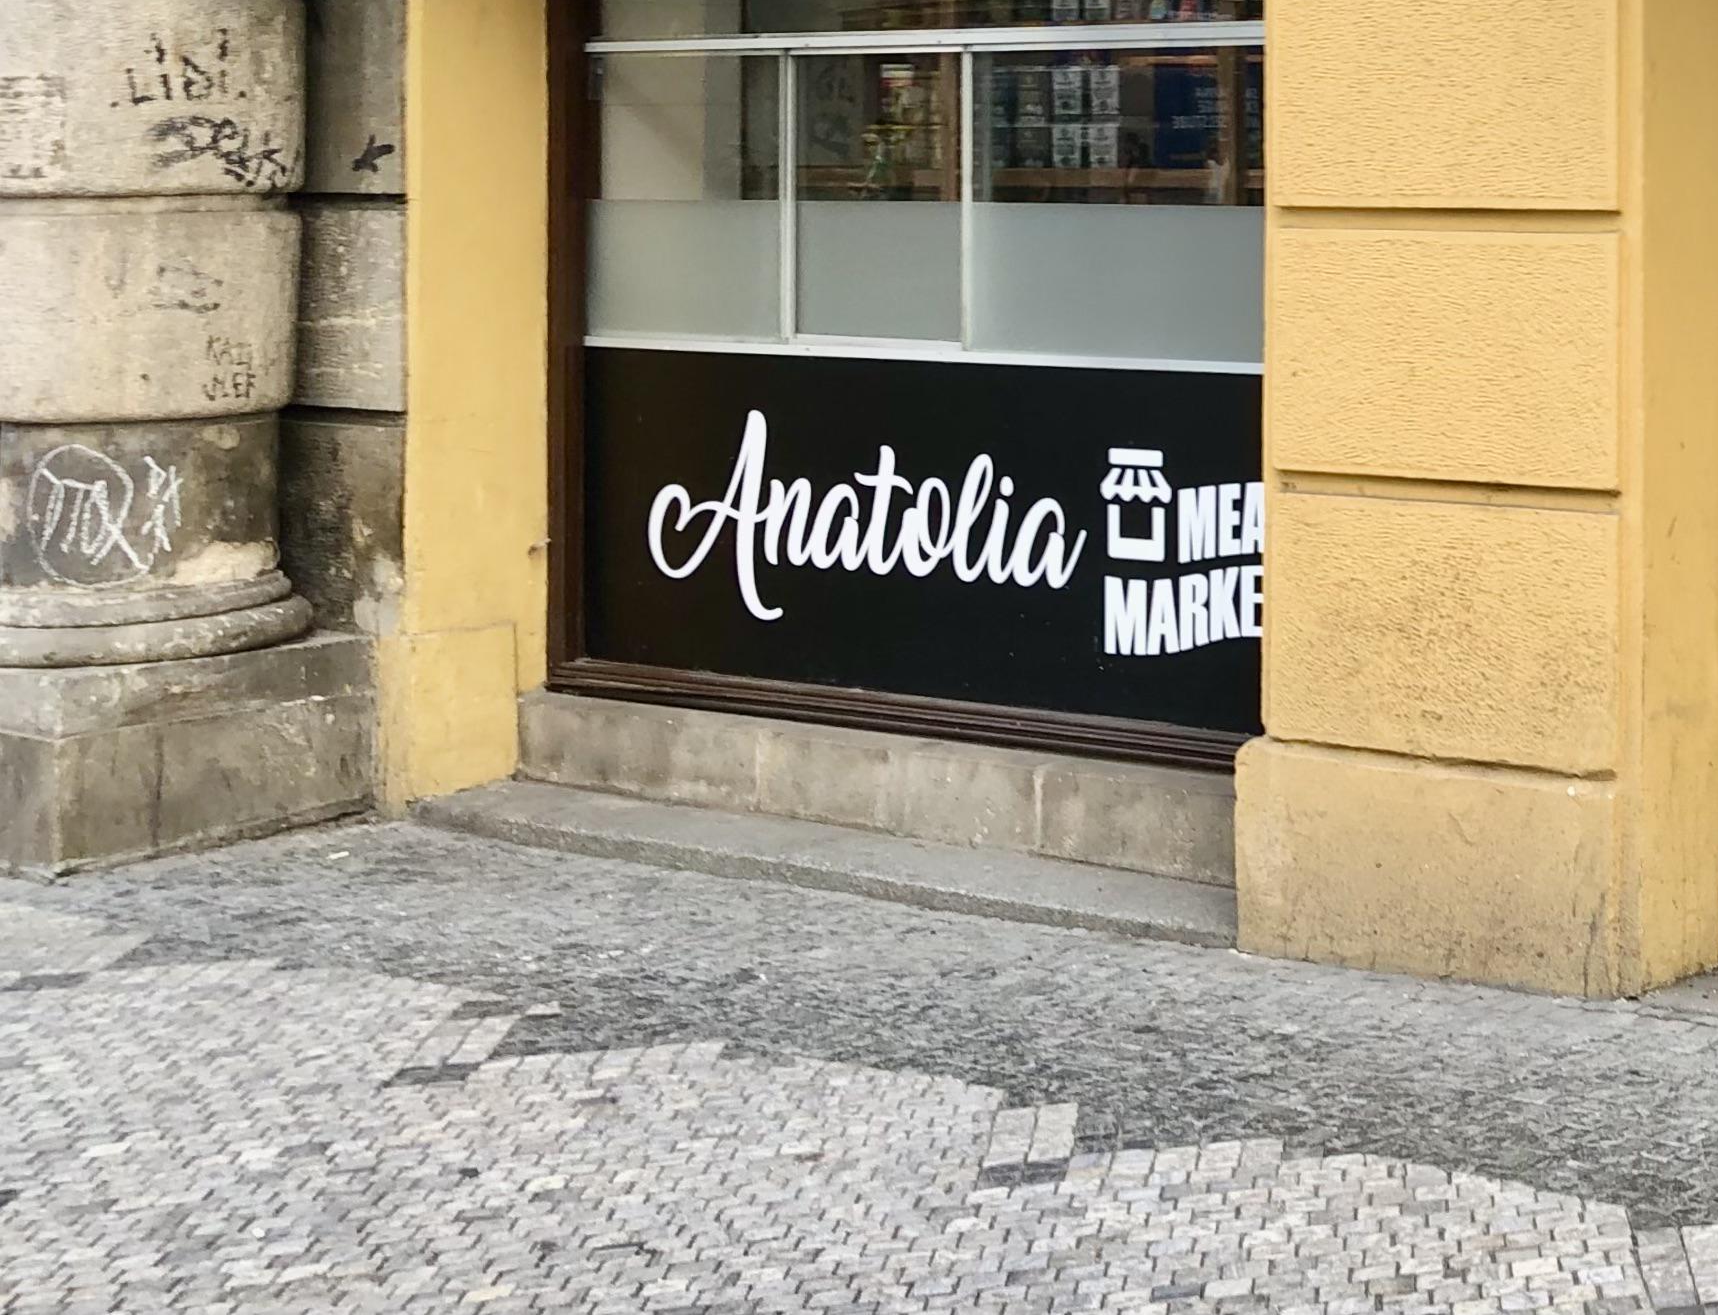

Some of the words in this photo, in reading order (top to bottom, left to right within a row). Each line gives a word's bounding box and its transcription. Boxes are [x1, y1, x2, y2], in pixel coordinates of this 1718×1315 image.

[647, 408, 1088, 621] Anatolia
[1177, 481, 1264, 565] MEA
[1103, 564, 1264, 657] MARKE
